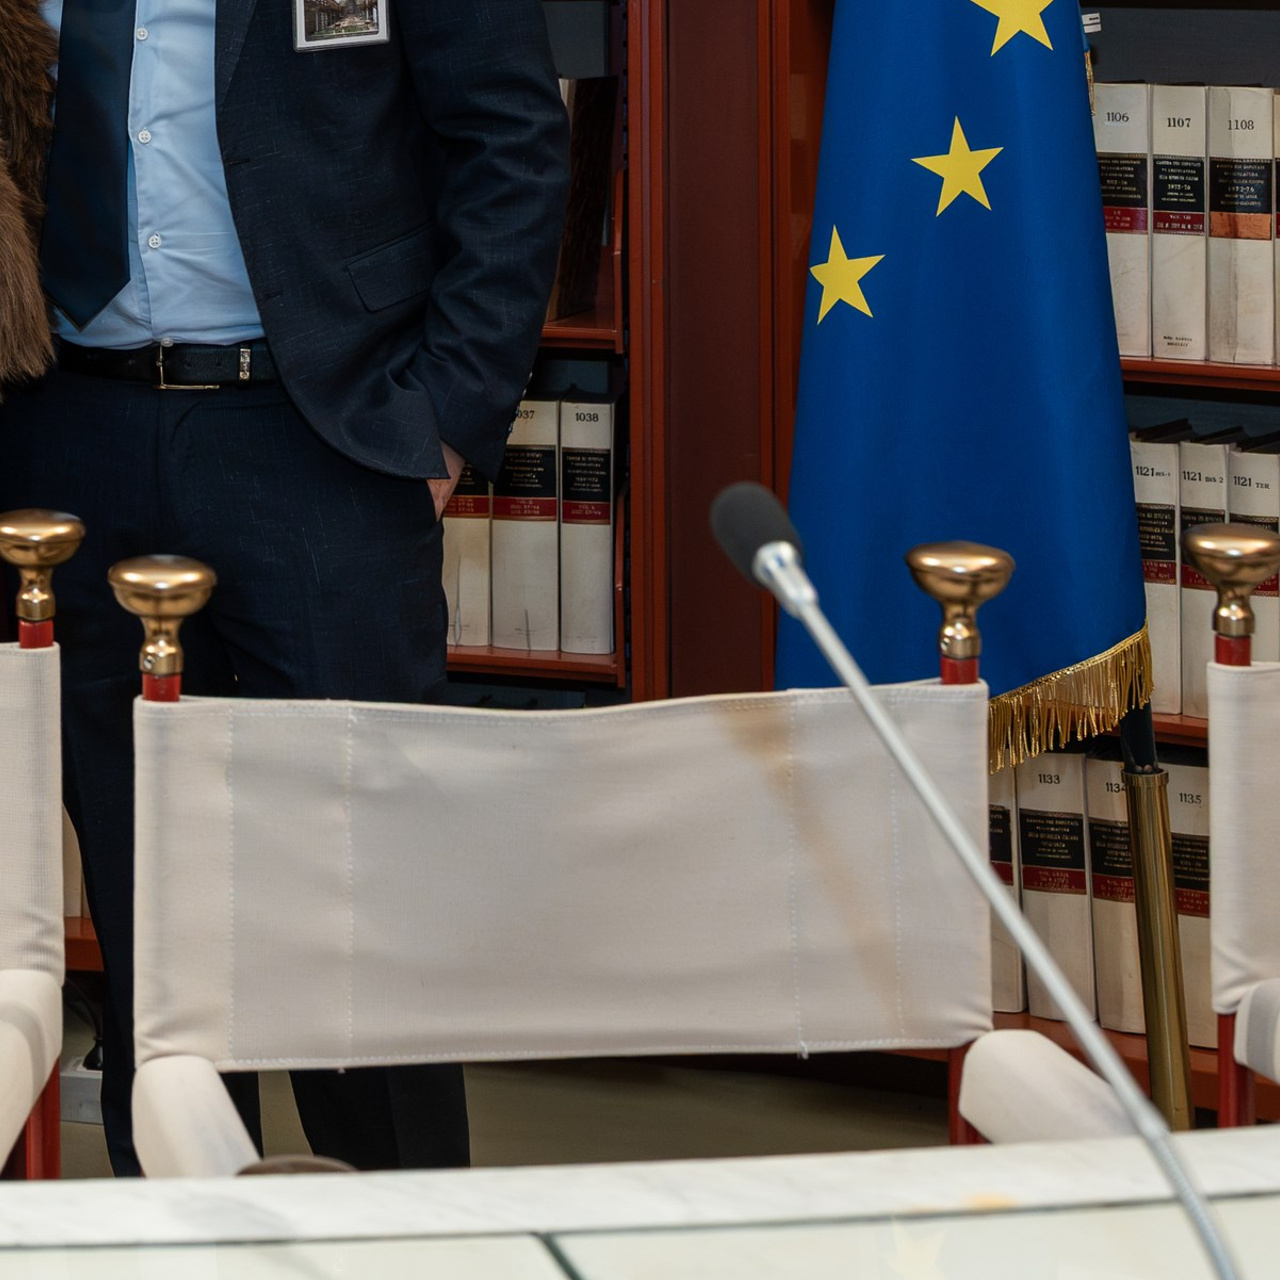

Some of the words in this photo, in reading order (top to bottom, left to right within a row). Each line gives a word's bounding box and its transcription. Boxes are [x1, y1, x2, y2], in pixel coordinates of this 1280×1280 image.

[1106, 112, 1129, 122] 1106
[1167, 117, 1191, 128] 1107
[1228, 119, 1254, 130] 1108
[575, 412, 599, 422] 1038
[1135, 466, 1155, 477] 1121
[1182, 470, 1202, 482] 1121
[1233, 475, 1252, 487] 1121
[1038, 773, 1061, 785] 1133
[1179, 792, 1202, 804] 1135
